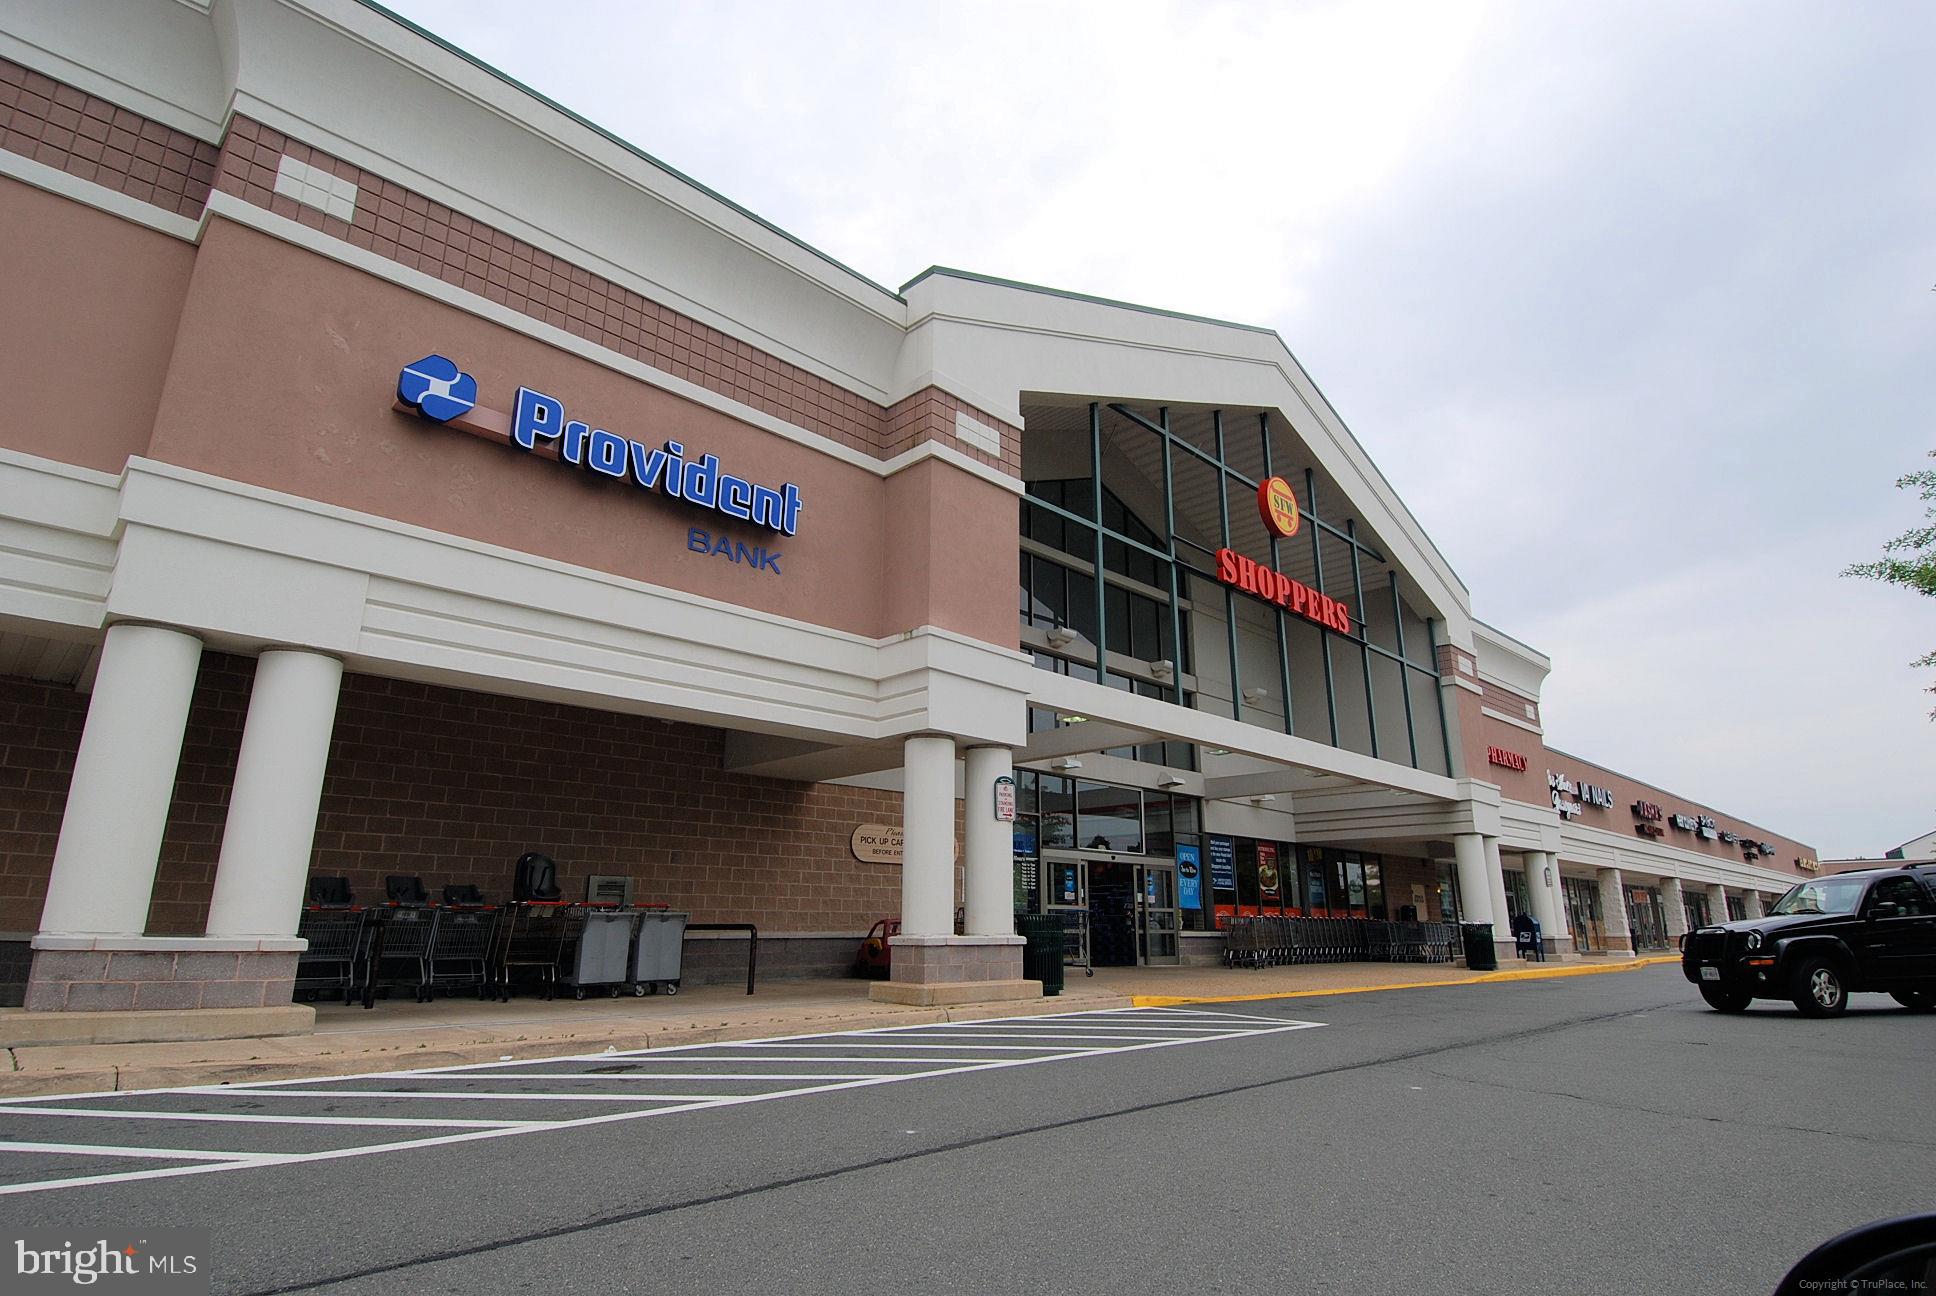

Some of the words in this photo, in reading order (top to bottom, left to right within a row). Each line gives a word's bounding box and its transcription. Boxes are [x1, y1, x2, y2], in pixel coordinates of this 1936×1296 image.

[511, 385, 802, 537] Provident
[1273, 493, 1294, 515] SFW
[687, 527, 783, 575] BANK
[1216, 548, 1353, 633] SHOPPERS
[1488, 745, 1528, 772] PHARMACY
[1592, 785, 1614, 809] NAILS
[860, 836, 876, 844] PICK
[1179, 853, 1194, 861] OPEN
[1180, 879, 1198, 888] EVERY
[1183, 887, 1194, 896] DAY
